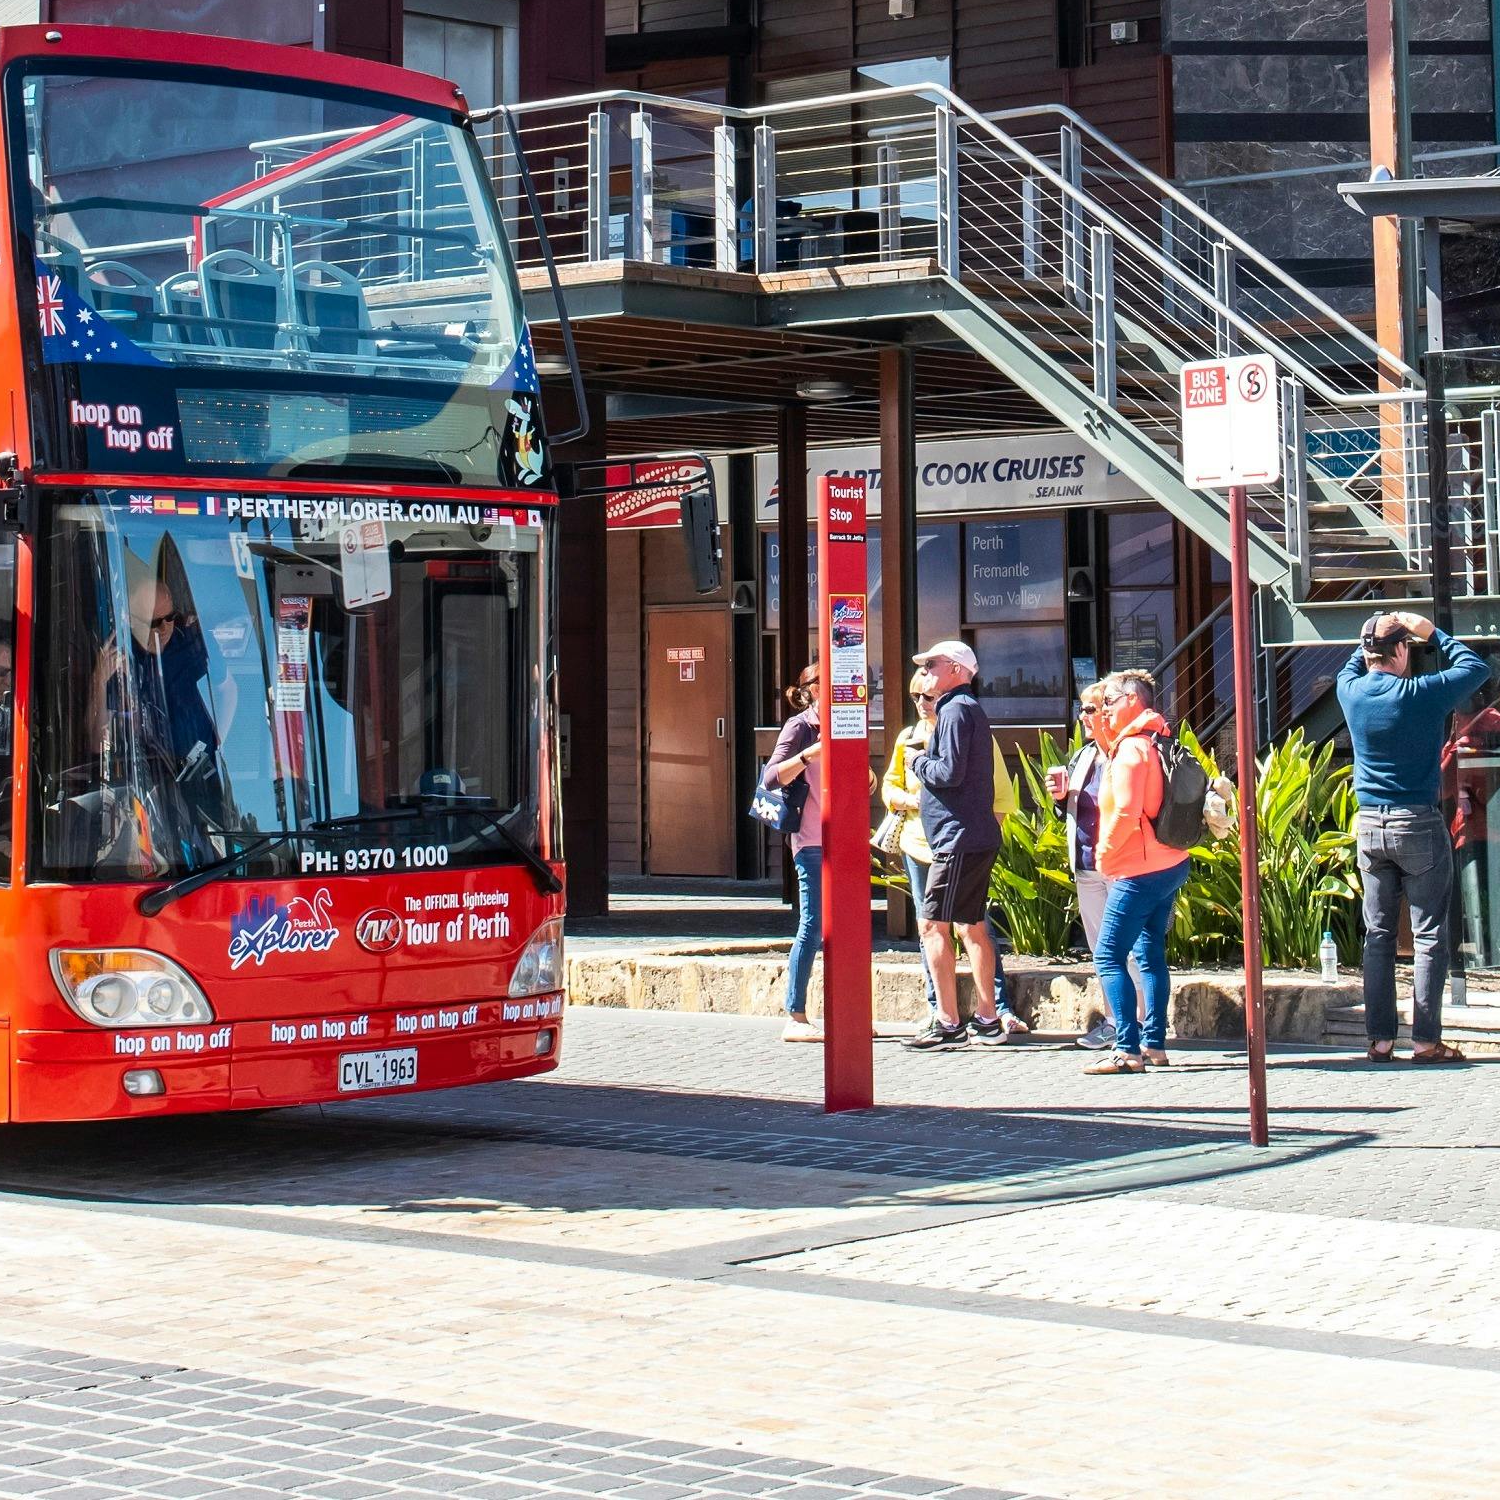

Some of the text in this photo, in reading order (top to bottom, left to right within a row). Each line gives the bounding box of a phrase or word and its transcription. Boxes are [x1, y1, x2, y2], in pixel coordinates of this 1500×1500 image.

[1192, 372, 1218, 388] BUS
[1189, 387, 1223, 405] ZONE
[70, 400, 143, 428] hop on
[106, 425, 174, 452] hop off
[922, 461, 990, 487] COOK
[992, 454, 1086, 482] CRUISES
[829, 485, 864, 499] Tourist
[1036, 485, 1084, 499] SEALINK
[226, 496, 480, 525] PERTHEXPLORER.COM.AU
[829, 507, 853, 523] Stop
[973, 534, 1004, 550] Perth
[973, 562, 1030, 578] Fremantle
[973, 590, 1041, 608] Swan Valley
[301, 844, 449, 873] PH: 9370 1000
[405, 890, 510, 912] The OFFICIAL Sightseeing
[293, 917, 317, 929] Perth
[404, 912, 510, 946] Tour of Perth
[396, 1005, 478, 1033] hop on hop off
[503, 994, 562, 1022] hop on hop off
[271, 1015, 368, 1044] hop on hop off
[115, 1028, 231, 1056] hop on hop off
